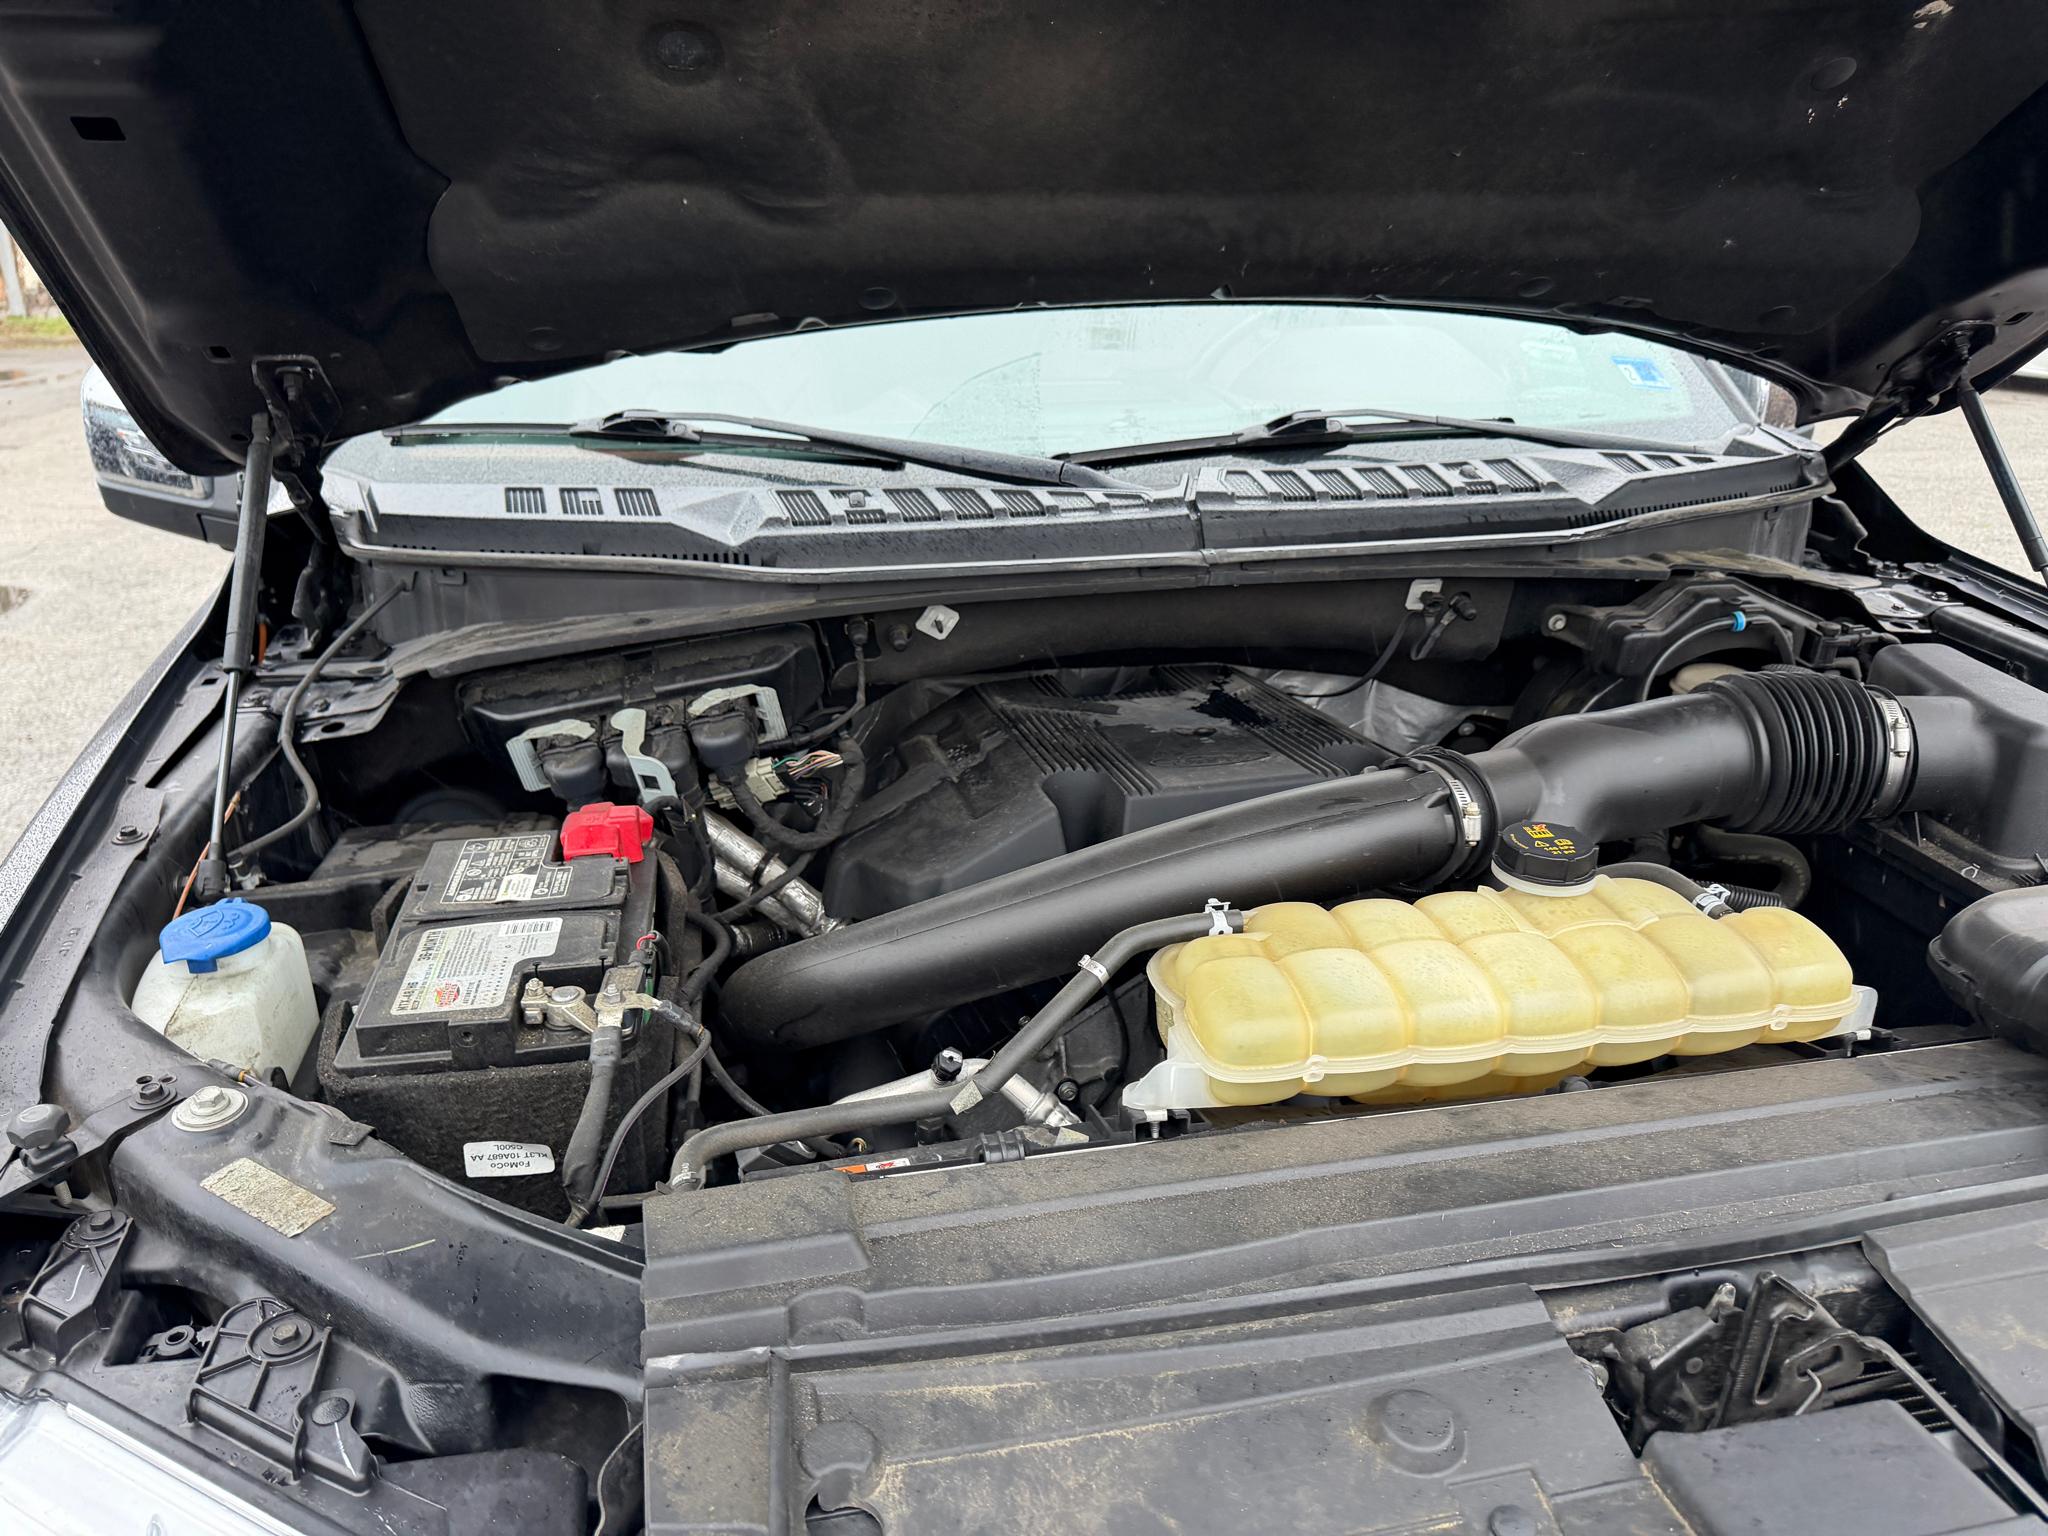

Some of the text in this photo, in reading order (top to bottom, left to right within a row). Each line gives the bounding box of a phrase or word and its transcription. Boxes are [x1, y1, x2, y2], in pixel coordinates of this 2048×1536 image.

[470, 1153, 484, 1162] AA
[487, 1152, 520, 1161] 10A687
[490, 1161, 531, 1169] FoMoCo
